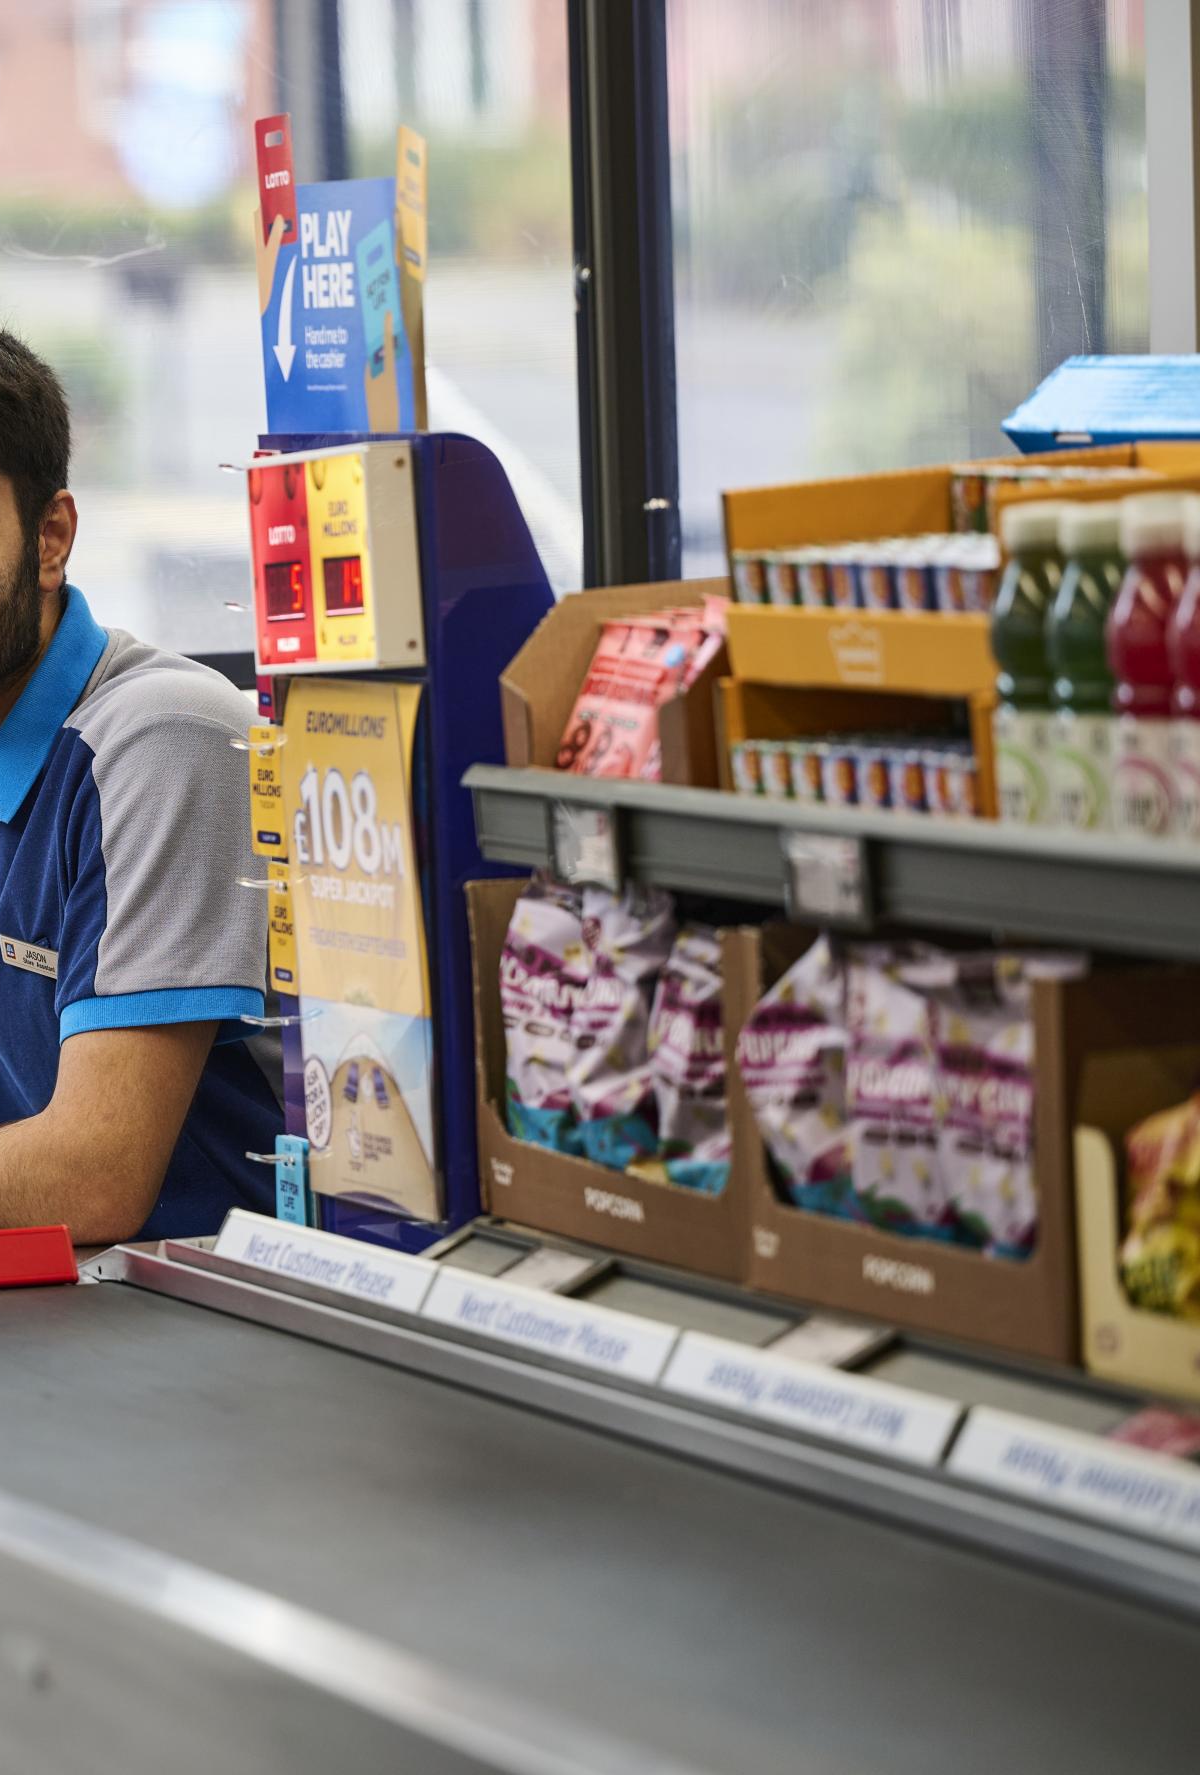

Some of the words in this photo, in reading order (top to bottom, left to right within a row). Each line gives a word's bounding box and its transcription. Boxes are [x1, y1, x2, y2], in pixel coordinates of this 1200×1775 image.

[264, 170, 291, 189] LOTTO
[300, 210, 351, 258] PLAY
[302, 262, 355, 309] HERE
[268, 525, 296, 545] LOTTO
[290, 563, 304, 610] 5
[305, 711, 386, 740] EUROMILLIONS
[253, 784, 281, 797] MILLIONS
[257, 769, 274, 782] EURO
[25, 950, 47, 963] JASON
[584, 1186, 645, 1223] POPCORN
[243, 1234, 280, 1267] Next
[277, 1243, 347, 1283] Customer
[345, 1261, 396, 1297] Please
[457, 1290, 497, 1325] Next
[496, 1302, 571, 1346] Customer
[571, 1321, 631, 1362] Please
